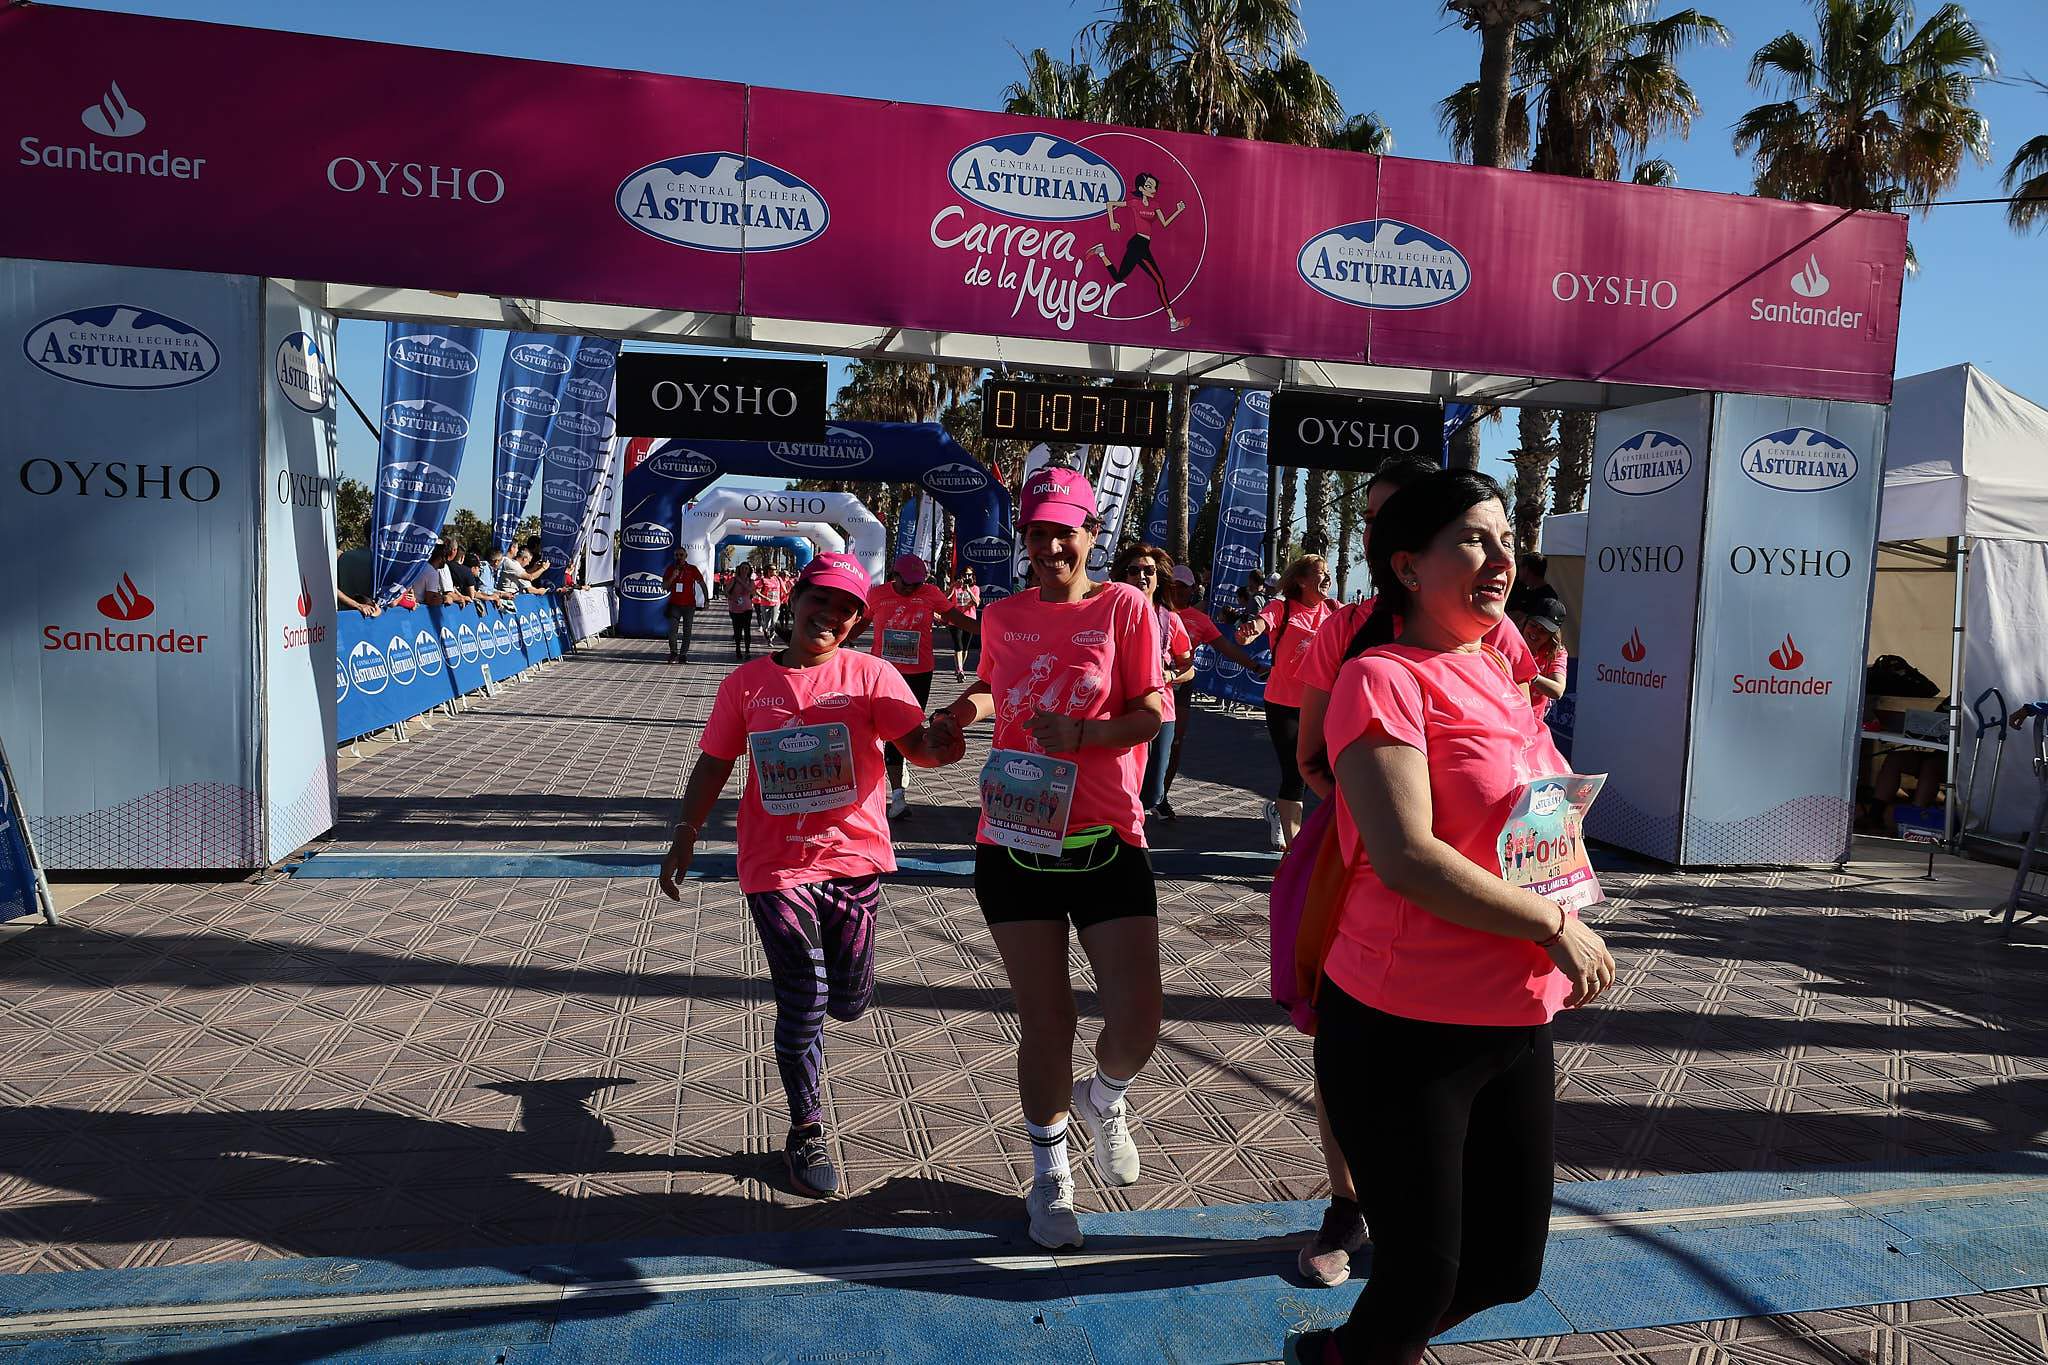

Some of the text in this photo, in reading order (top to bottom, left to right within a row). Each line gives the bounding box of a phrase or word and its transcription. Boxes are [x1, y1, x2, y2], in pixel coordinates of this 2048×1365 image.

[19, 136, 206, 180] Santander
[990, 158, 1107, 179] CENTRAL LECHERA
[326, 156, 505, 204] OYSHO
[666, 182, 733, 197] CENTRAL
[961, 158, 1110, 204] ASTURIANA
[632, 182, 813, 231] ASTURIANA
[931, 205, 1076, 261] Carrera
[1310, 246, 1457, 291] ASTURIANA
[1338, 246, 1453, 265] CENTRAL LECHERA
[964, 256, 1127, 331] de la Mujer
[1552, 272, 1678, 310] OYSHO
[1750, 298, 1862, 329] Santander
[39, 331, 206, 372] ASTURIANA
[69, 331, 199, 348] CENTRAL LECHERA
[394, 343, 471, 371] ASTURIANA
[515, 349, 567, 371] ASTURIANA
[651, 380, 798, 417] OYSHO
[386, 408, 463, 436] ASTURIANA
[995, 390, 1154, 436] 01:07:11
[1298, 417, 1420, 451] OYSHO
[776, 440, 866, 460] ASTURIANA
[1622, 448, 1684, 463] CENTRAL LECHERA
[1748, 448, 1849, 478] ASTURIANA
[1767, 448, 1848, 460] CENTRAL LECHERA
[653, 458, 711, 473] ASTURIANA
[1608, 456, 1684, 483] ASTURIANA
[20, 458, 221, 503] OYSHO
[277, 469, 331, 510] OYSHO
[927, 474, 984, 487] ASTURIANA
[1033, 483, 1070, 495] DRUNI
[743, 494, 826, 515] OYSHO
[625, 531, 671, 545] ASTURIANA
[833, 560, 864, 581] DRUNI
[1598, 544, 1684, 573] OYSHO
[1730, 545, 1851, 578] OYSHO
[43, 626, 208, 653] Santander
[283, 624, 327, 650] Santander
[1004, 631, 1040, 642] OYSHO
[1597, 663, 1668, 689] Santander
[1732, 674, 1833, 695] Santander
[747, 697, 785, 709] OYSHO
[781, 739, 819, 750] ASTURIANA
[786, 764, 822, 782] 016
[1006, 764, 1042, 779] ASTURIANA
[1003, 793, 1036, 813] 016
[1030, 827, 1058, 839] VALENCIA
[1536, 834, 1568, 863] 016
[1538, 884, 1549, 894] DE
